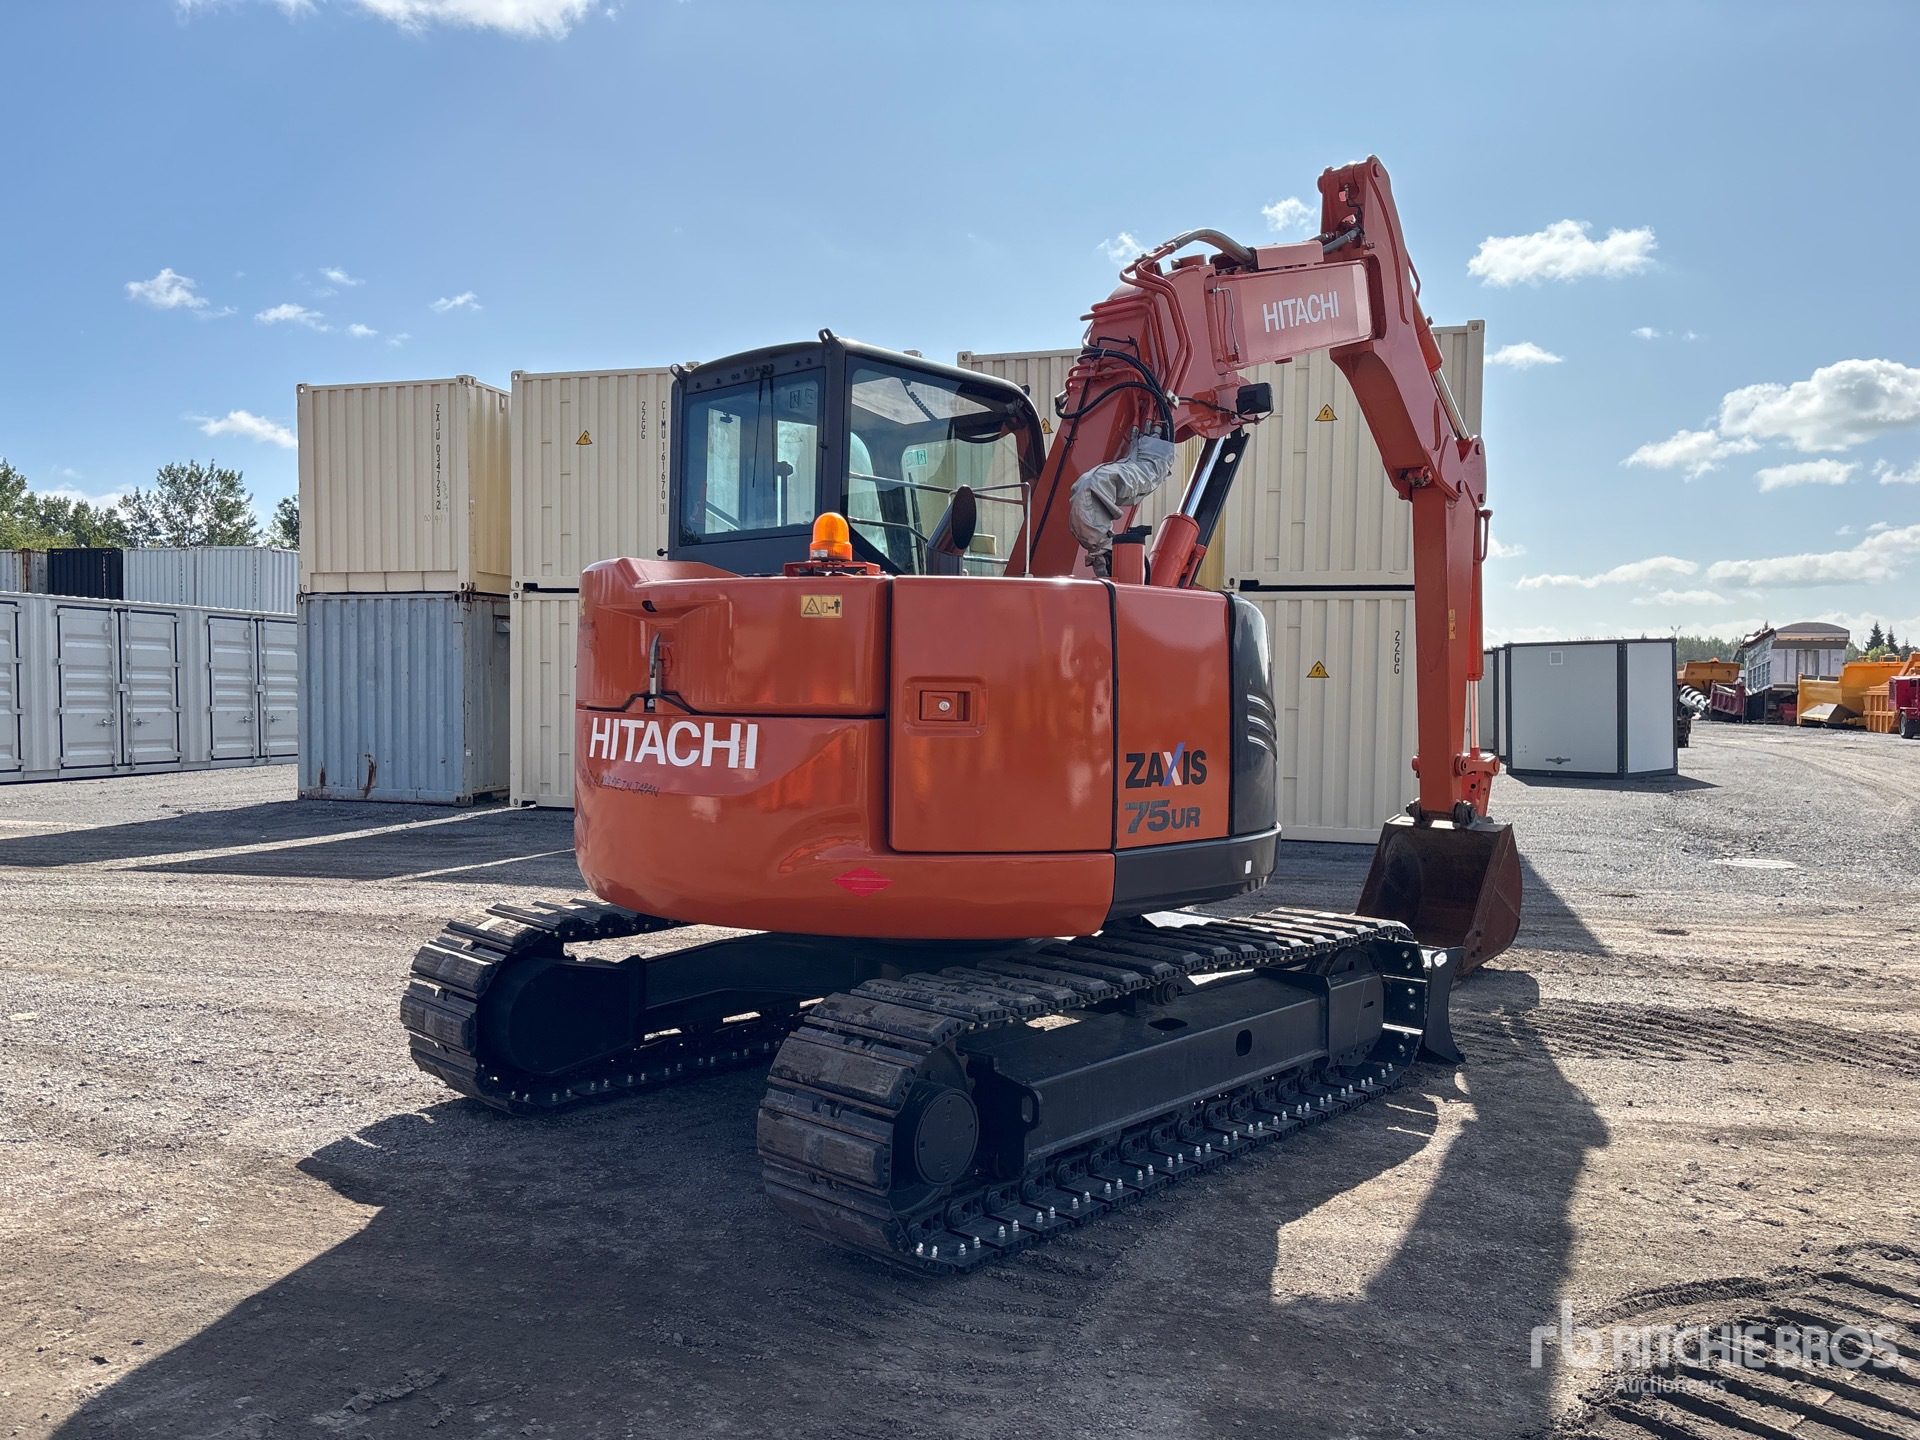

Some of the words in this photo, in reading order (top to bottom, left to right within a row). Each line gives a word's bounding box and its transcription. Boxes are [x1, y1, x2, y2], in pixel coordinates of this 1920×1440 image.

[1263, 291, 1339, 332] HITACHI
[589, 717, 758, 769] HITACHI
[1125, 742, 1207, 789] ZAXIS
